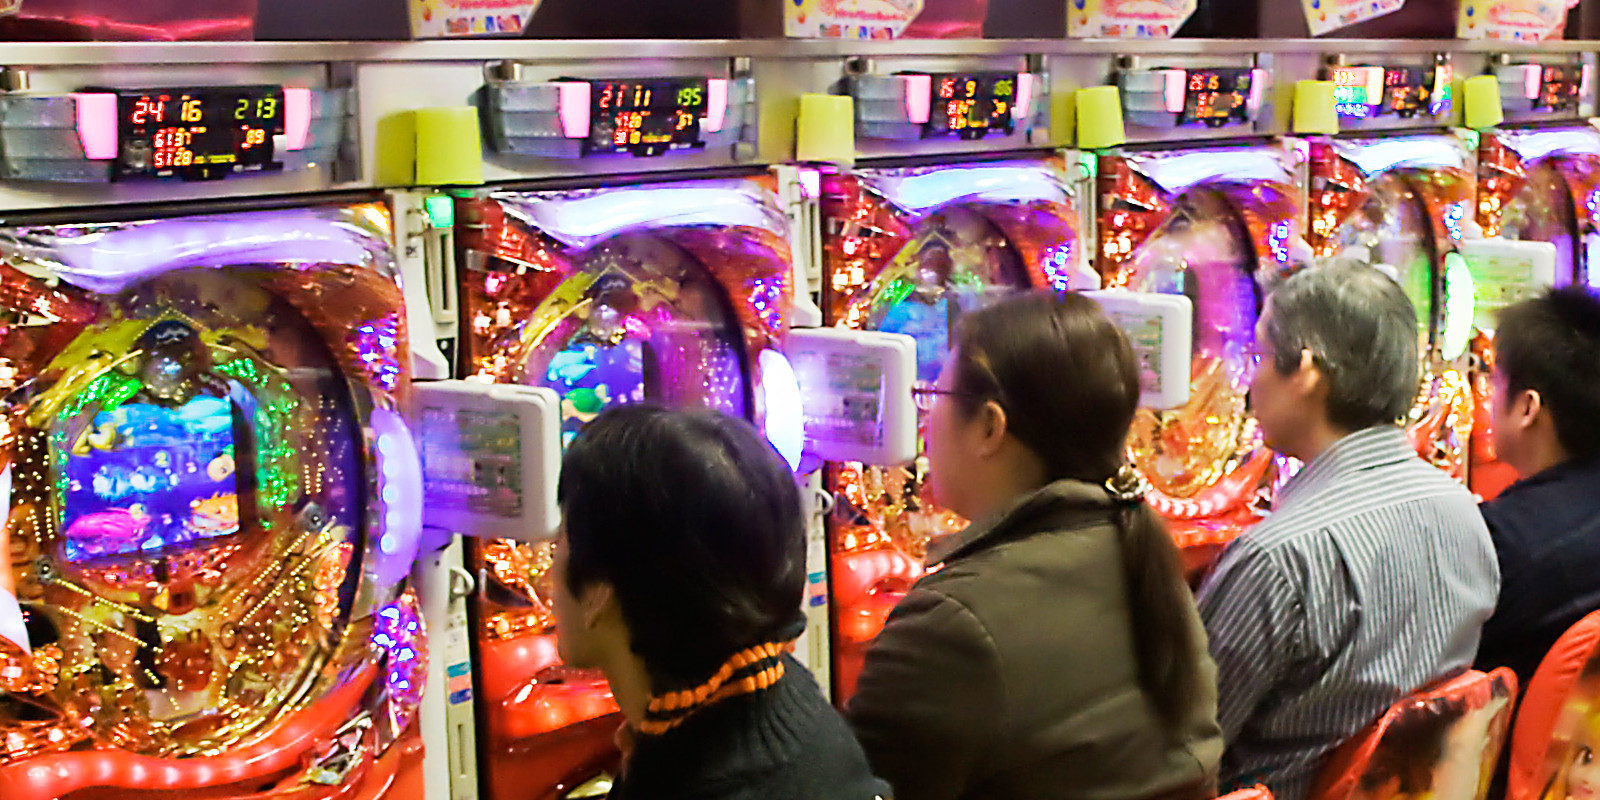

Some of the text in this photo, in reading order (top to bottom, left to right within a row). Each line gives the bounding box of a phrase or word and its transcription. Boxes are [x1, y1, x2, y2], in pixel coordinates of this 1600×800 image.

[599, 87, 702, 108] 21 11 195
[132, 98, 276, 124] 24 16 213
[154, 131, 191, 148] 6137
[153, 150, 192, 168] 5128
